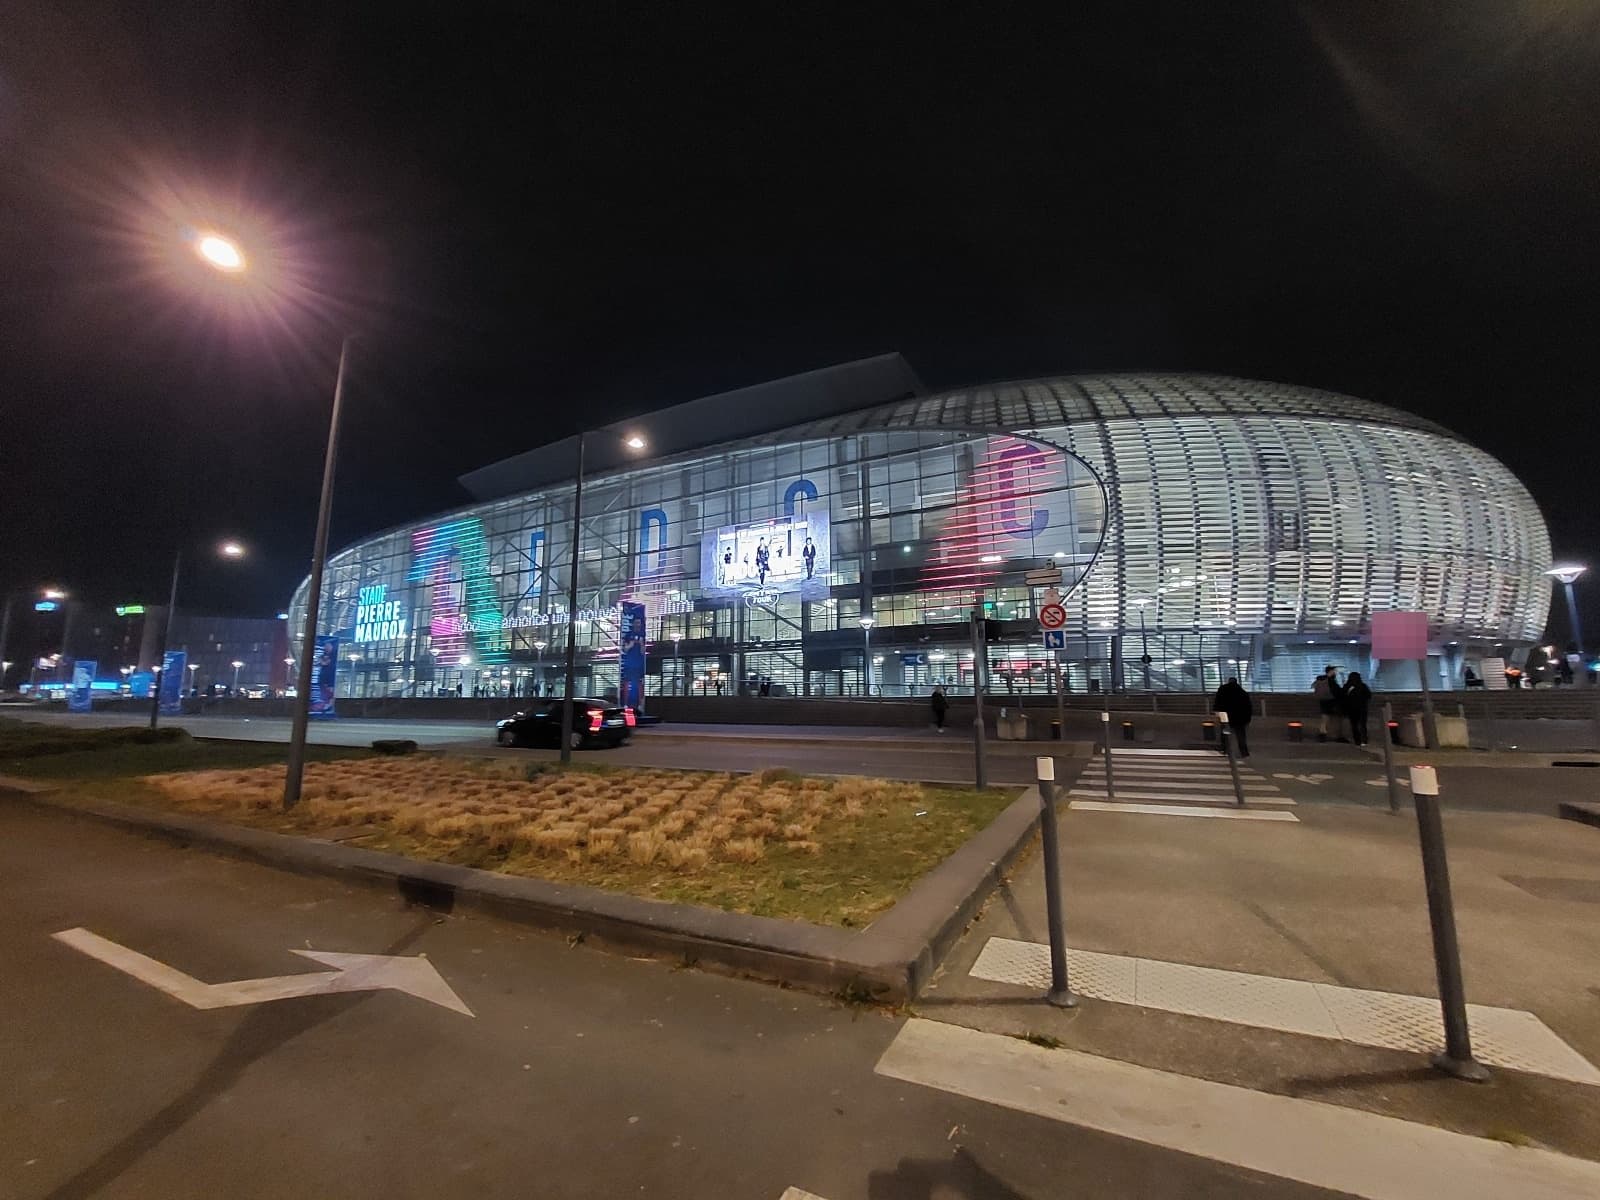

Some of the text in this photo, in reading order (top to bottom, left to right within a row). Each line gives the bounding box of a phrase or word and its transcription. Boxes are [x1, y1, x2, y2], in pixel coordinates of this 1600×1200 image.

[359, 584, 388, 605] STADE
[356, 601, 401, 624] PIERRE
[502, 614, 550, 629] annonce
[354, 619, 407, 643] MAUROY
